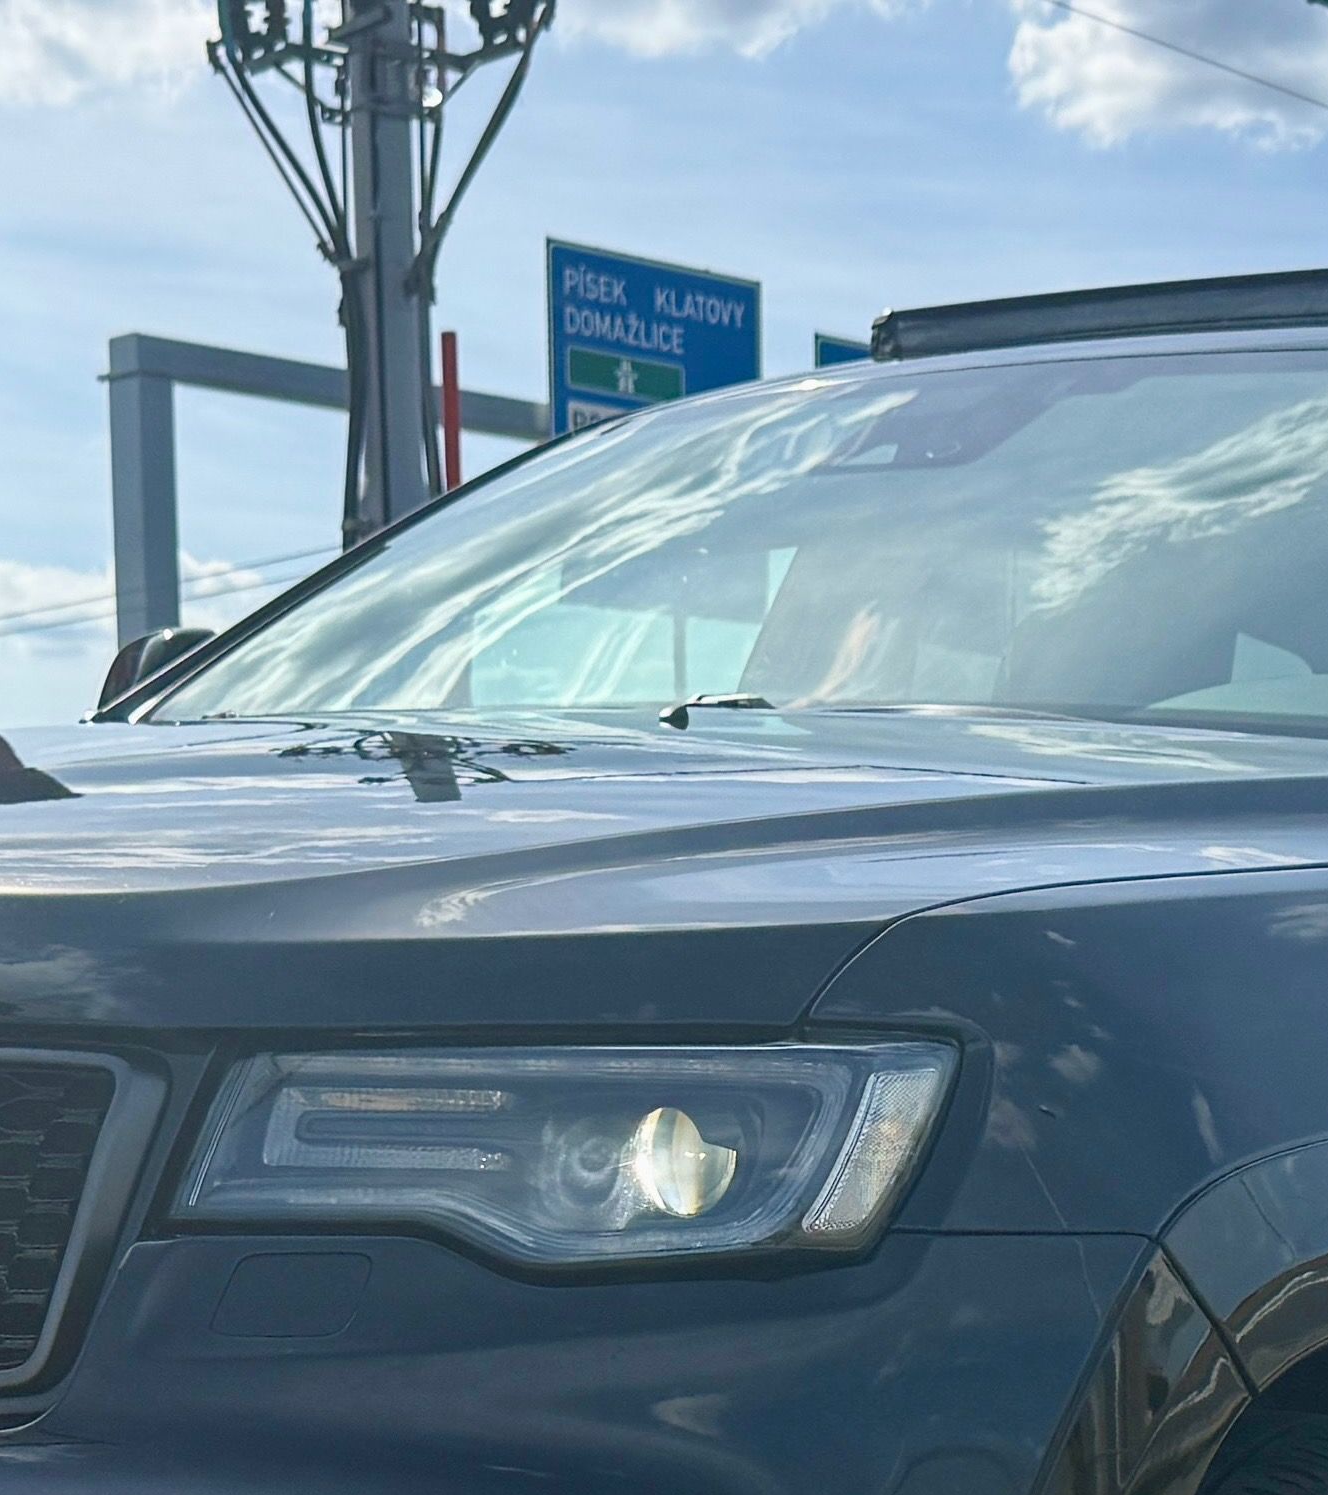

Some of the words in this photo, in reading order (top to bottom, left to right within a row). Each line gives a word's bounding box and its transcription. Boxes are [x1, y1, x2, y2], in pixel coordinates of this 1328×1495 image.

[563, 264, 627, 306] PÍSEK
[654, 286, 746, 328] KLATOVY
[563, 306, 685, 355] DOMAŽLICE
